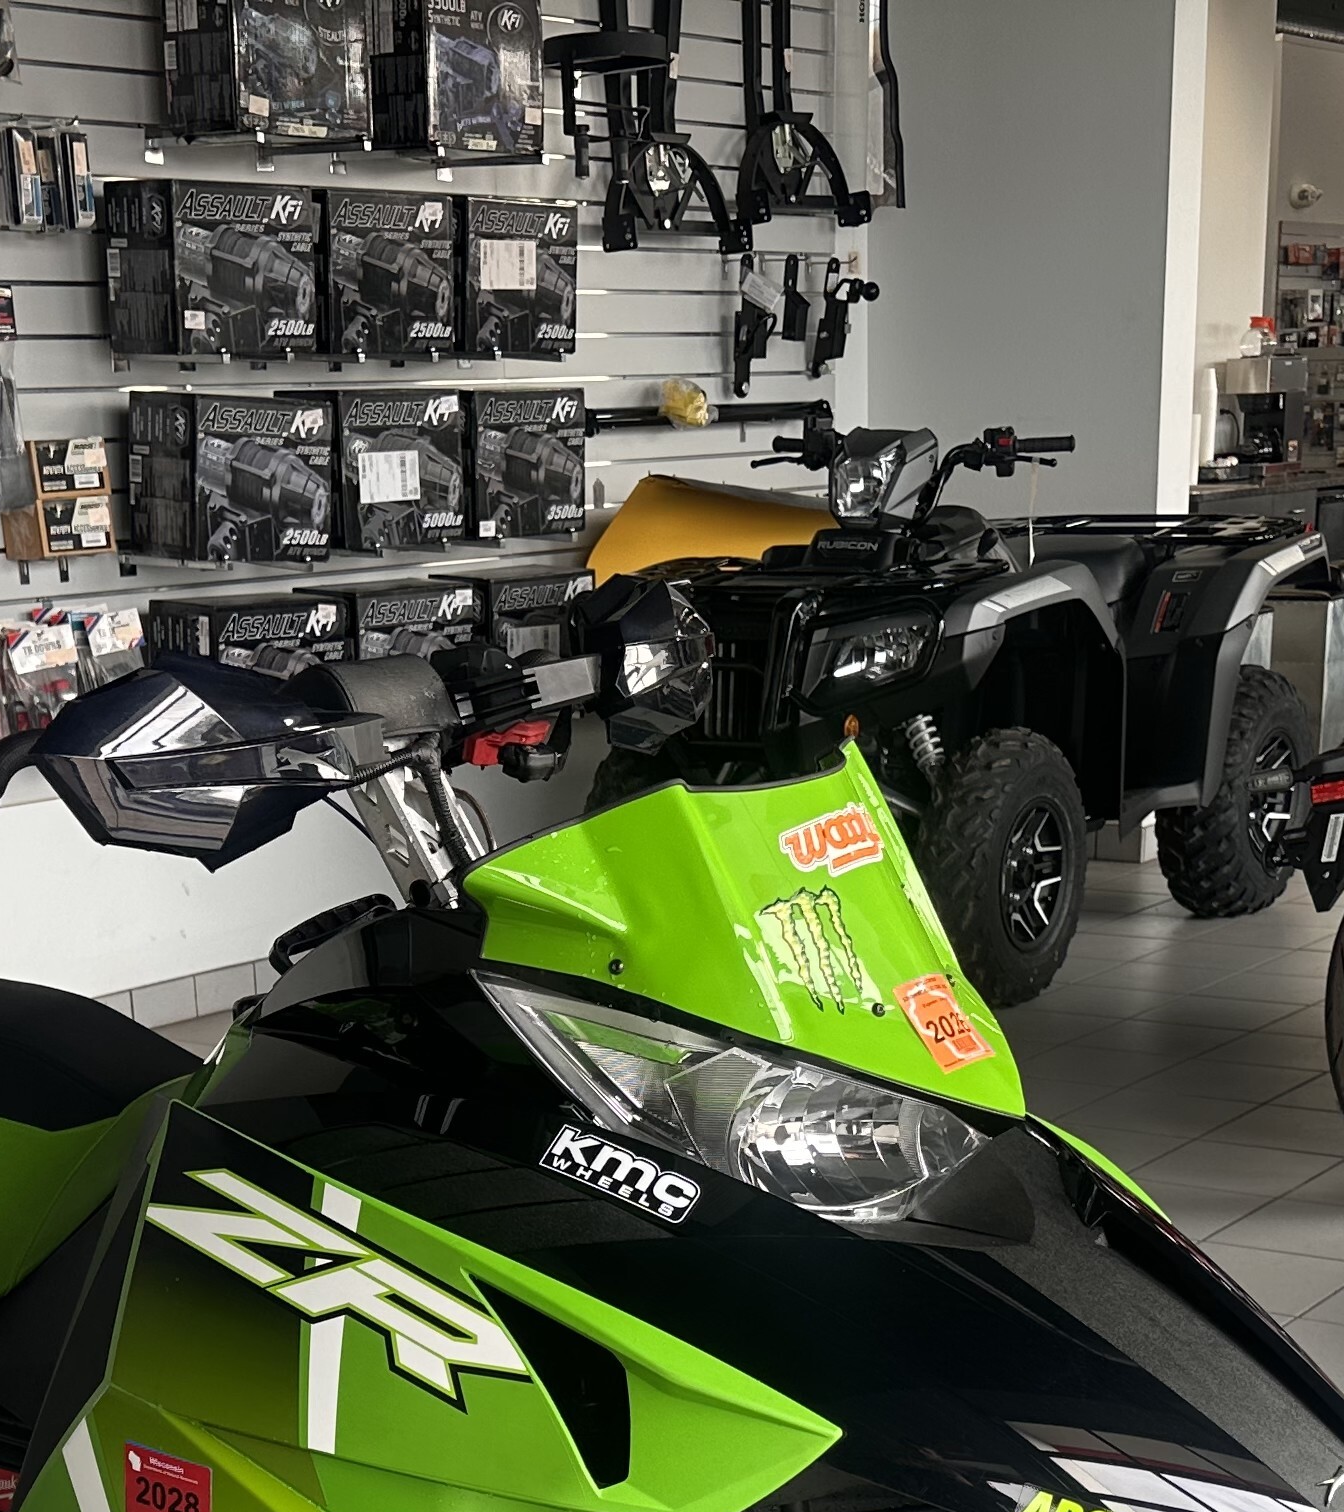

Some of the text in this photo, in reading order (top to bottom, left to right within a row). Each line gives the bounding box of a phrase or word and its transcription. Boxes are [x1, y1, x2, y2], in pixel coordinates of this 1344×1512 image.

[174, 188, 273, 220] ASSAULT
[331, 197, 416, 230] ASSAULT
[470, 205, 546, 236] ASSAULT
[268, 319, 316, 337] 2500LB
[410, 322, 452, 338] 2500LB
[537, 322, 575, 340] 2500LB
[198, 402, 293, 435] ASSAULT
[343, 398, 425, 427] ASSAULT
[478, 397, 554, 425] ASSAULT
[422, 511, 464, 529] 5000LB
[282, 527, 330, 546] 2500LB
[816, 540, 879, 552] RUBICON
[494, 583, 567, 612] ASSAULT
[361, 598, 438, 627] ASSAULT
[218, 612, 308, 643] ASSAULT
[551, 1155, 675, 1217] WHEELS
[146, 1168, 530, 1400] ZR
